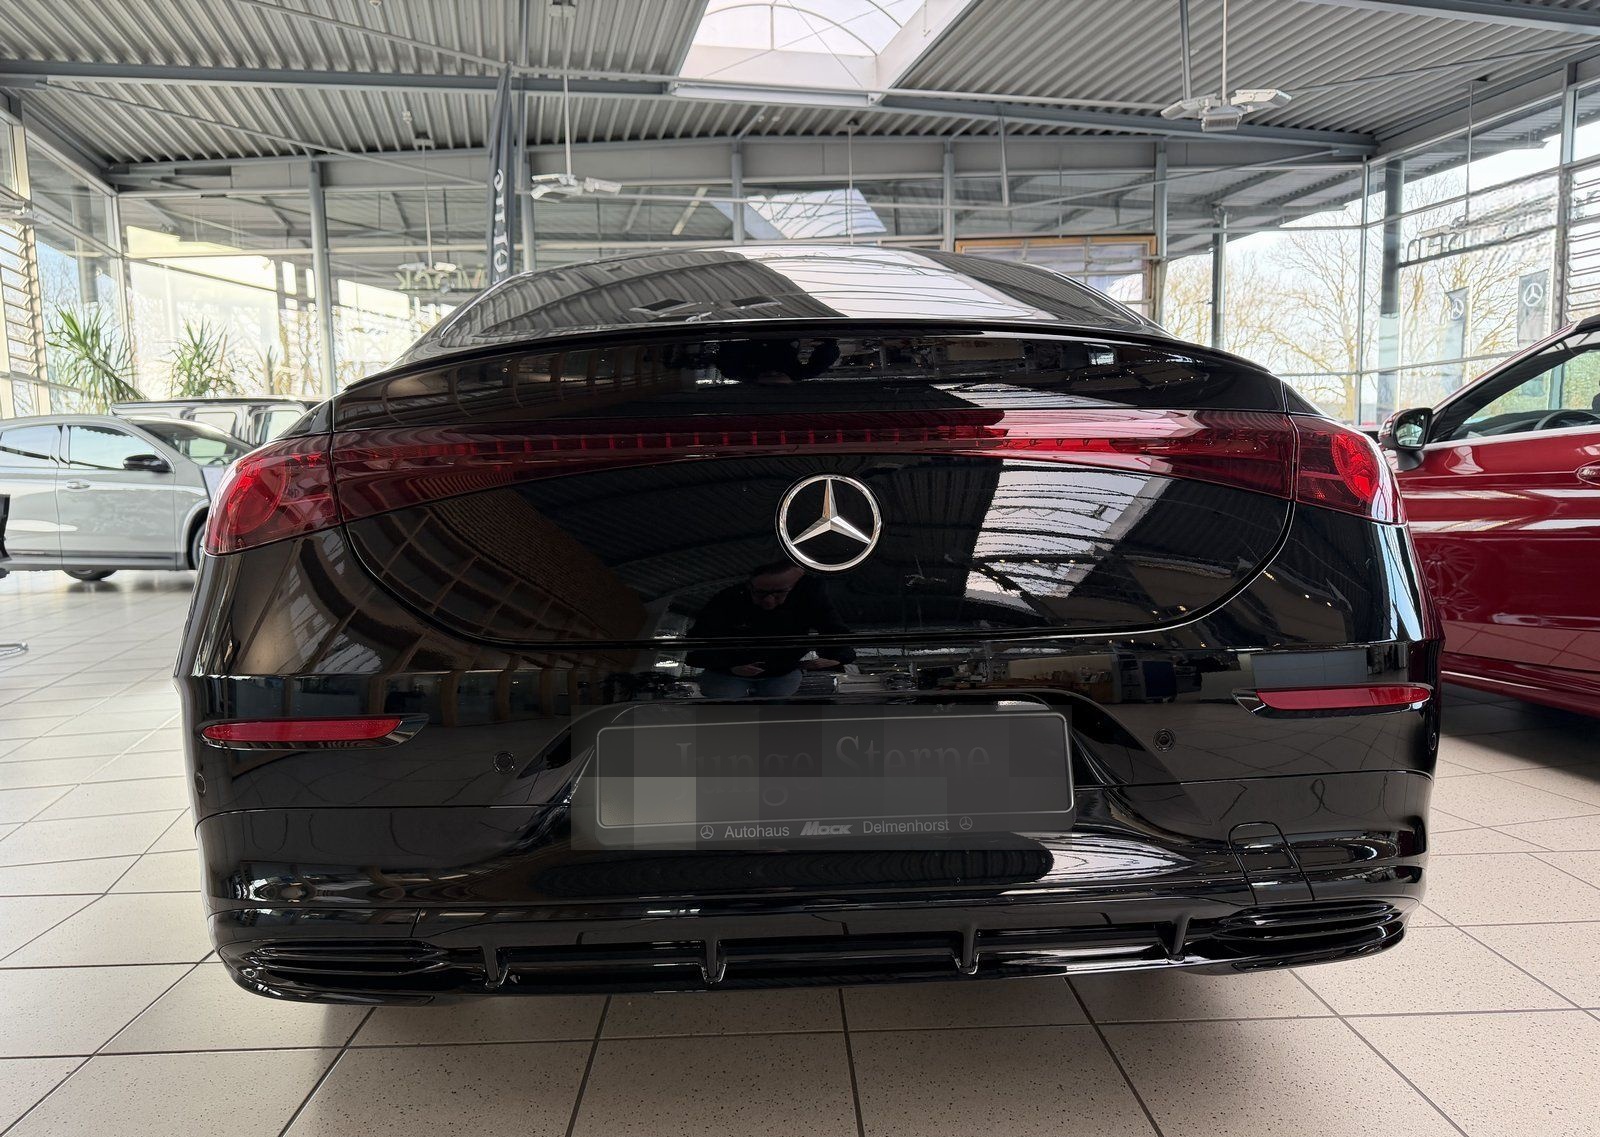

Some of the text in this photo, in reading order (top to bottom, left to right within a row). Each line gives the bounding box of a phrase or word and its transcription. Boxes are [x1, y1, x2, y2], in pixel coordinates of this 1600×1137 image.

[674, 734, 992, 807] Junge Sterne
[723, 824, 791, 839] Autohaus
[862, 818, 950, 835] Delmenhorst
